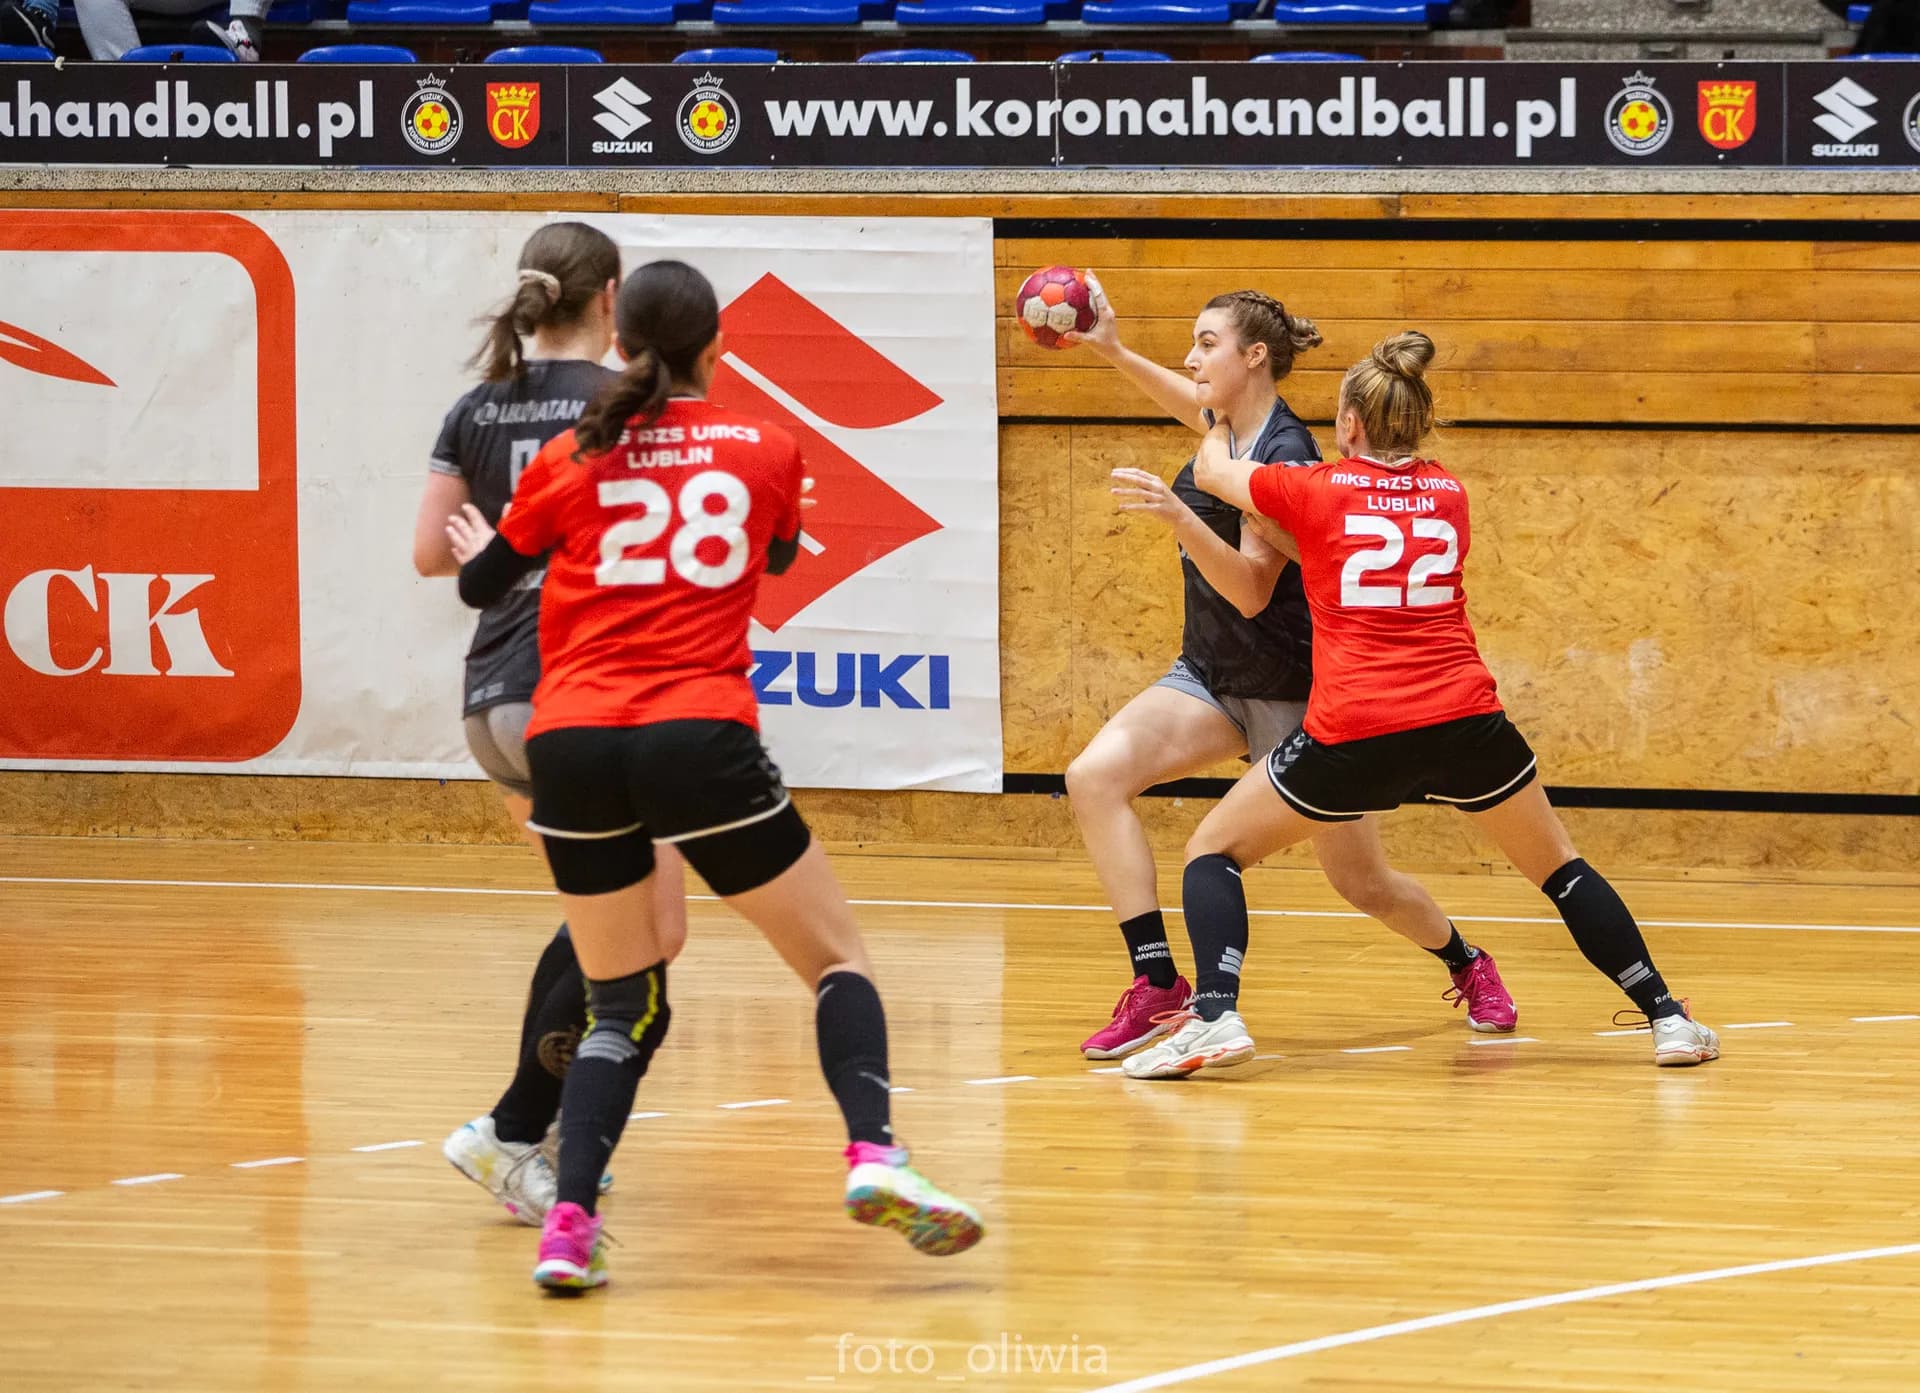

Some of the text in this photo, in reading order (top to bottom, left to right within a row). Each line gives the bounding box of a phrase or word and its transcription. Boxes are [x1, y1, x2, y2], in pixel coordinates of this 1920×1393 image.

[696, 91, 720, 101] SUZUKI
[492, 108, 530, 141] CK
[764, 77, 1576, 159] www.koronahandball.pl
[1703, 107, 1745, 142] CK
[592, 141, 653, 154] SUZUKI
[1811, 143, 1880, 157] SUZUKI
[637, 426, 685, 444] AZS
[691, 423, 761, 444] UMCS
[627, 446, 714, 469] LUBLIN
[1376, 475, 1413, 490] AZS
[1416, 477, 1461, 492] UMCS
[1367, 495, 1435, 512] LUBLIN
[594, 470, 751, 588] 28
[1340, 514, 1458, 608] 22
[4, 563, 235, 677] CK
[749, 650, 950, 710] ZUKI
